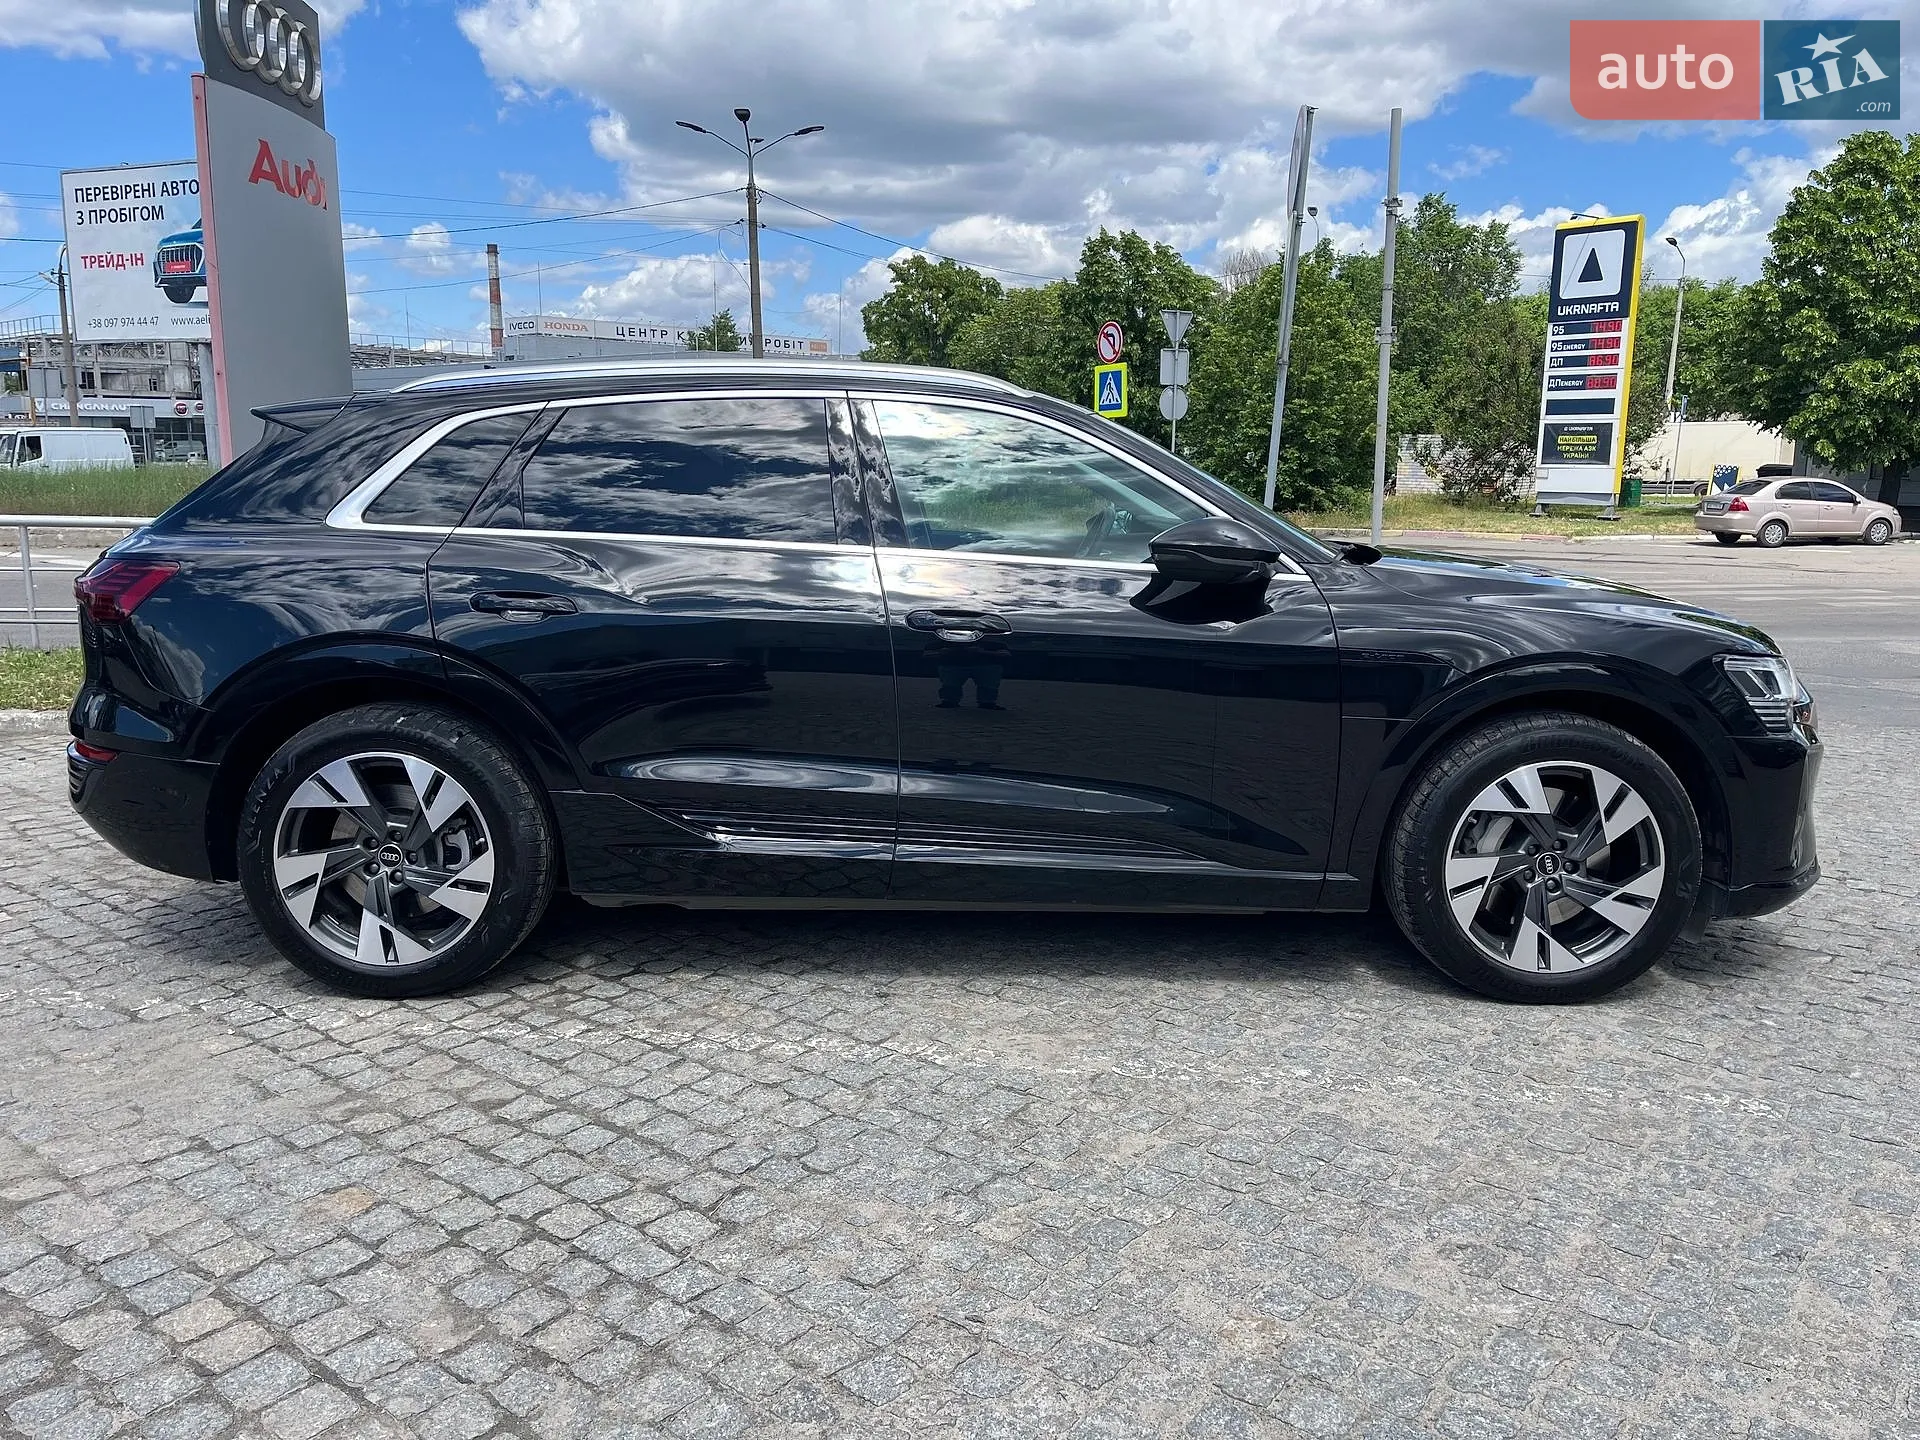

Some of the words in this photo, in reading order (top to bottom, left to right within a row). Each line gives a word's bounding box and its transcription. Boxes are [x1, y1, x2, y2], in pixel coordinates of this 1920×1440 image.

[248, 138, 328, 210] Audi
[74, 182, 156, 203] ПЕРЕВІРЕНІ
[160, 179, 200, 197] АВТО
[76, 210, 84, 225] З
[88, 205, 165, 225] ПРОБІГОМ
[81, 251, 145, 271] ТРЕЙД-ІН
[1557, 302, 1619, 316] UKRNAFTA
[88, 318, 102, 328] +38
[104, 317, 118, 327] 097
[120, 317, 135, 327] 974
[137, 316, 148, 326] 44
[149, 316, 159, 326] 47
[509, 321, 535, 331] IVECO
[544, 321, 589, 332] HONDA
[616, 326, 668, 339] ЦЕНТР
[1553, 325, 1565, 335] 95
[764, 338, 804, 350] РОБІТ
[1551, 342, 1563, 351] 95
[1551, 358, 1563, 367] ДП
[1549, 379, 1561, 389] ДП
